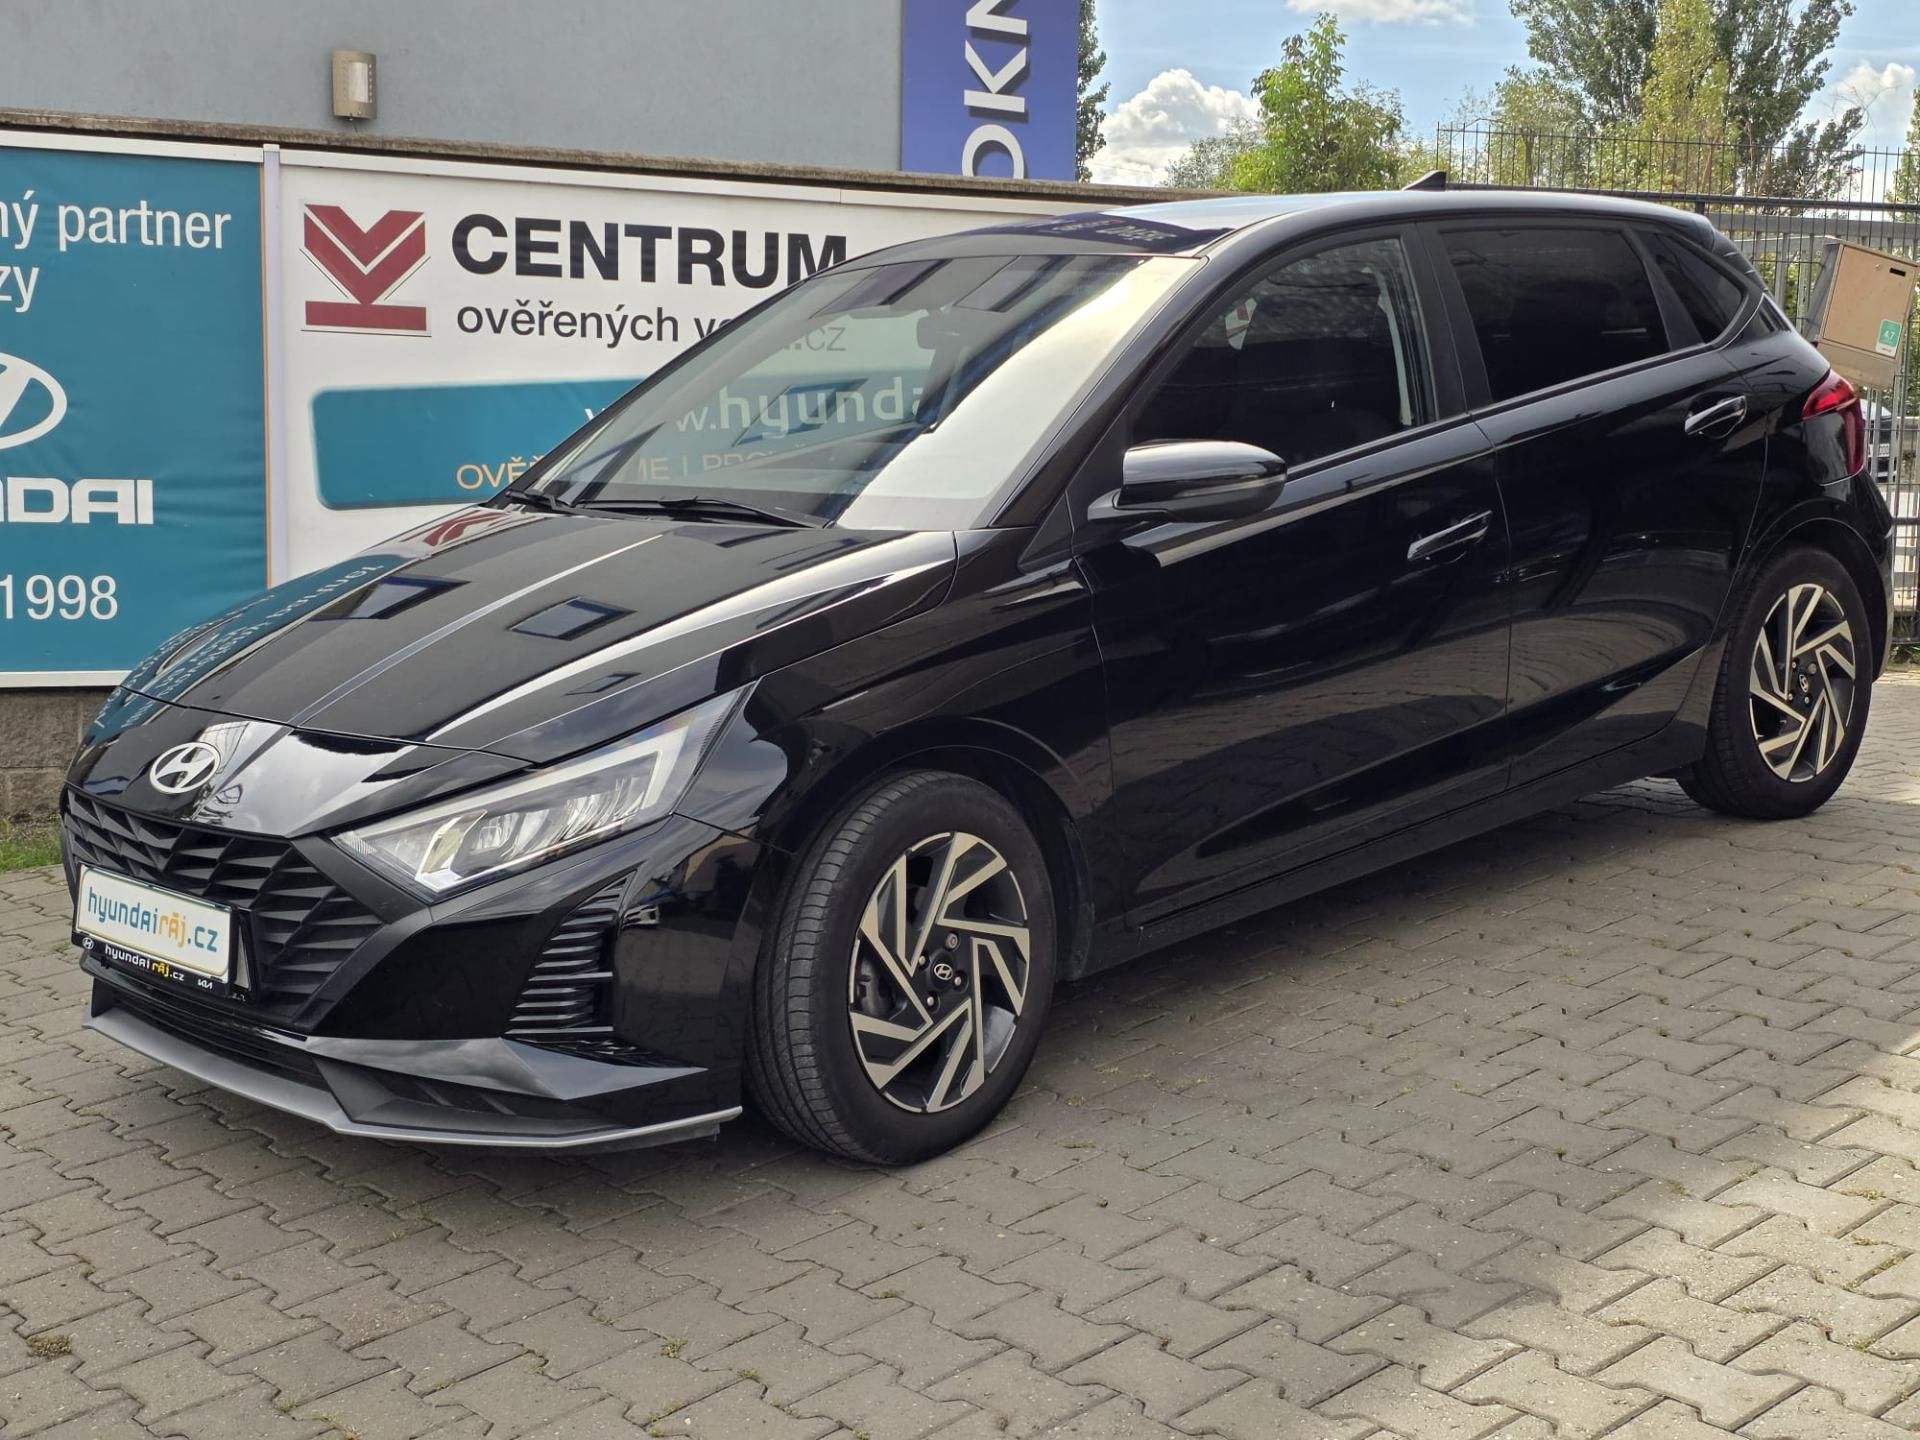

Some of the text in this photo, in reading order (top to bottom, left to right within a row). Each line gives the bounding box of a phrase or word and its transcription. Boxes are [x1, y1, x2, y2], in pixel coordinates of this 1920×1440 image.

[58, 200, 232, 252] partner
[452, 213, 847, 289] CENTRUM
[456, 299, 679, 348] ověřených
[676, 376, 925, 438] w.hyund
[456, 456, 545, 490] OVĚ
[0, 477, 154, 525] DAI
[0, 574, 118, 620] 1998
